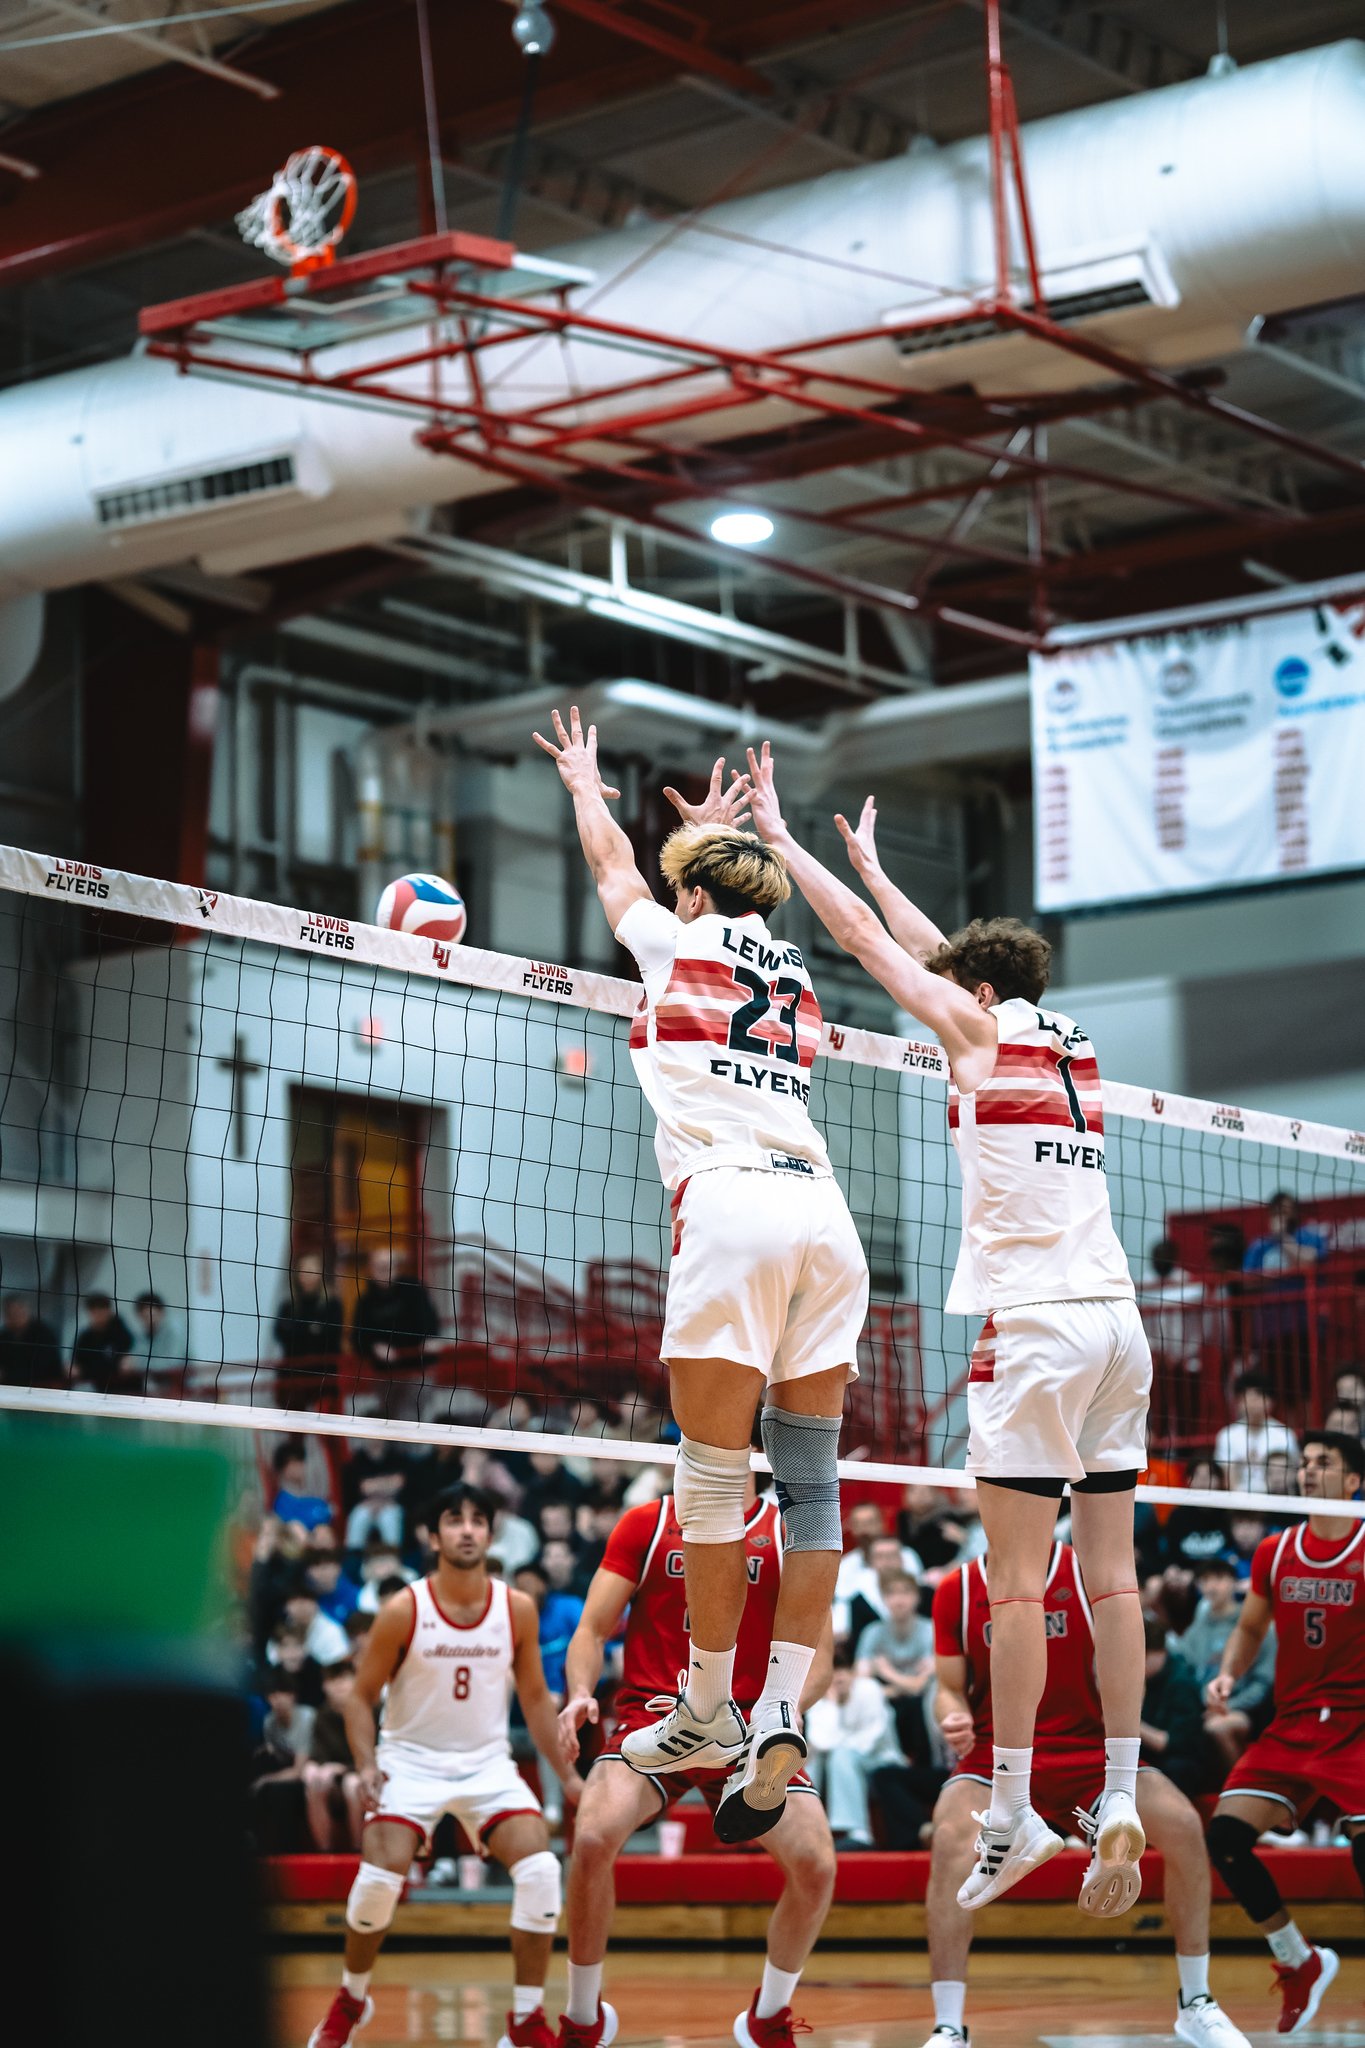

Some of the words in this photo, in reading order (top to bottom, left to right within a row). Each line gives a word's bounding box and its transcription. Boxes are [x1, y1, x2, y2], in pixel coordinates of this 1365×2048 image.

[55, 859, 103, 880] LEWIS
[45, 873, 110, 899] FLYERS
[307, 913, 350, 933] LEWIS
[299, 926, 355, 950] FLYERS
[530, 961, 568, 980] LEWIS
[523, 973, 574, 996] FLYERS
[727, 964, 804, 1066] 23
[907, 1041, 939, 1057] LEWIS
[902, 1052, 943, 1072] FLYERS
[710, 1059, 811, 1107] FLYERS
[1055, 1055, 1087, 1134] 1
[1211, 1115, 1245, 1132] FLYERS
[1280, 1576, 1356, 1607] CSUN
[1304, 1607, 1327, 1650] 5
[453, 1665, 471, 1701] 8
